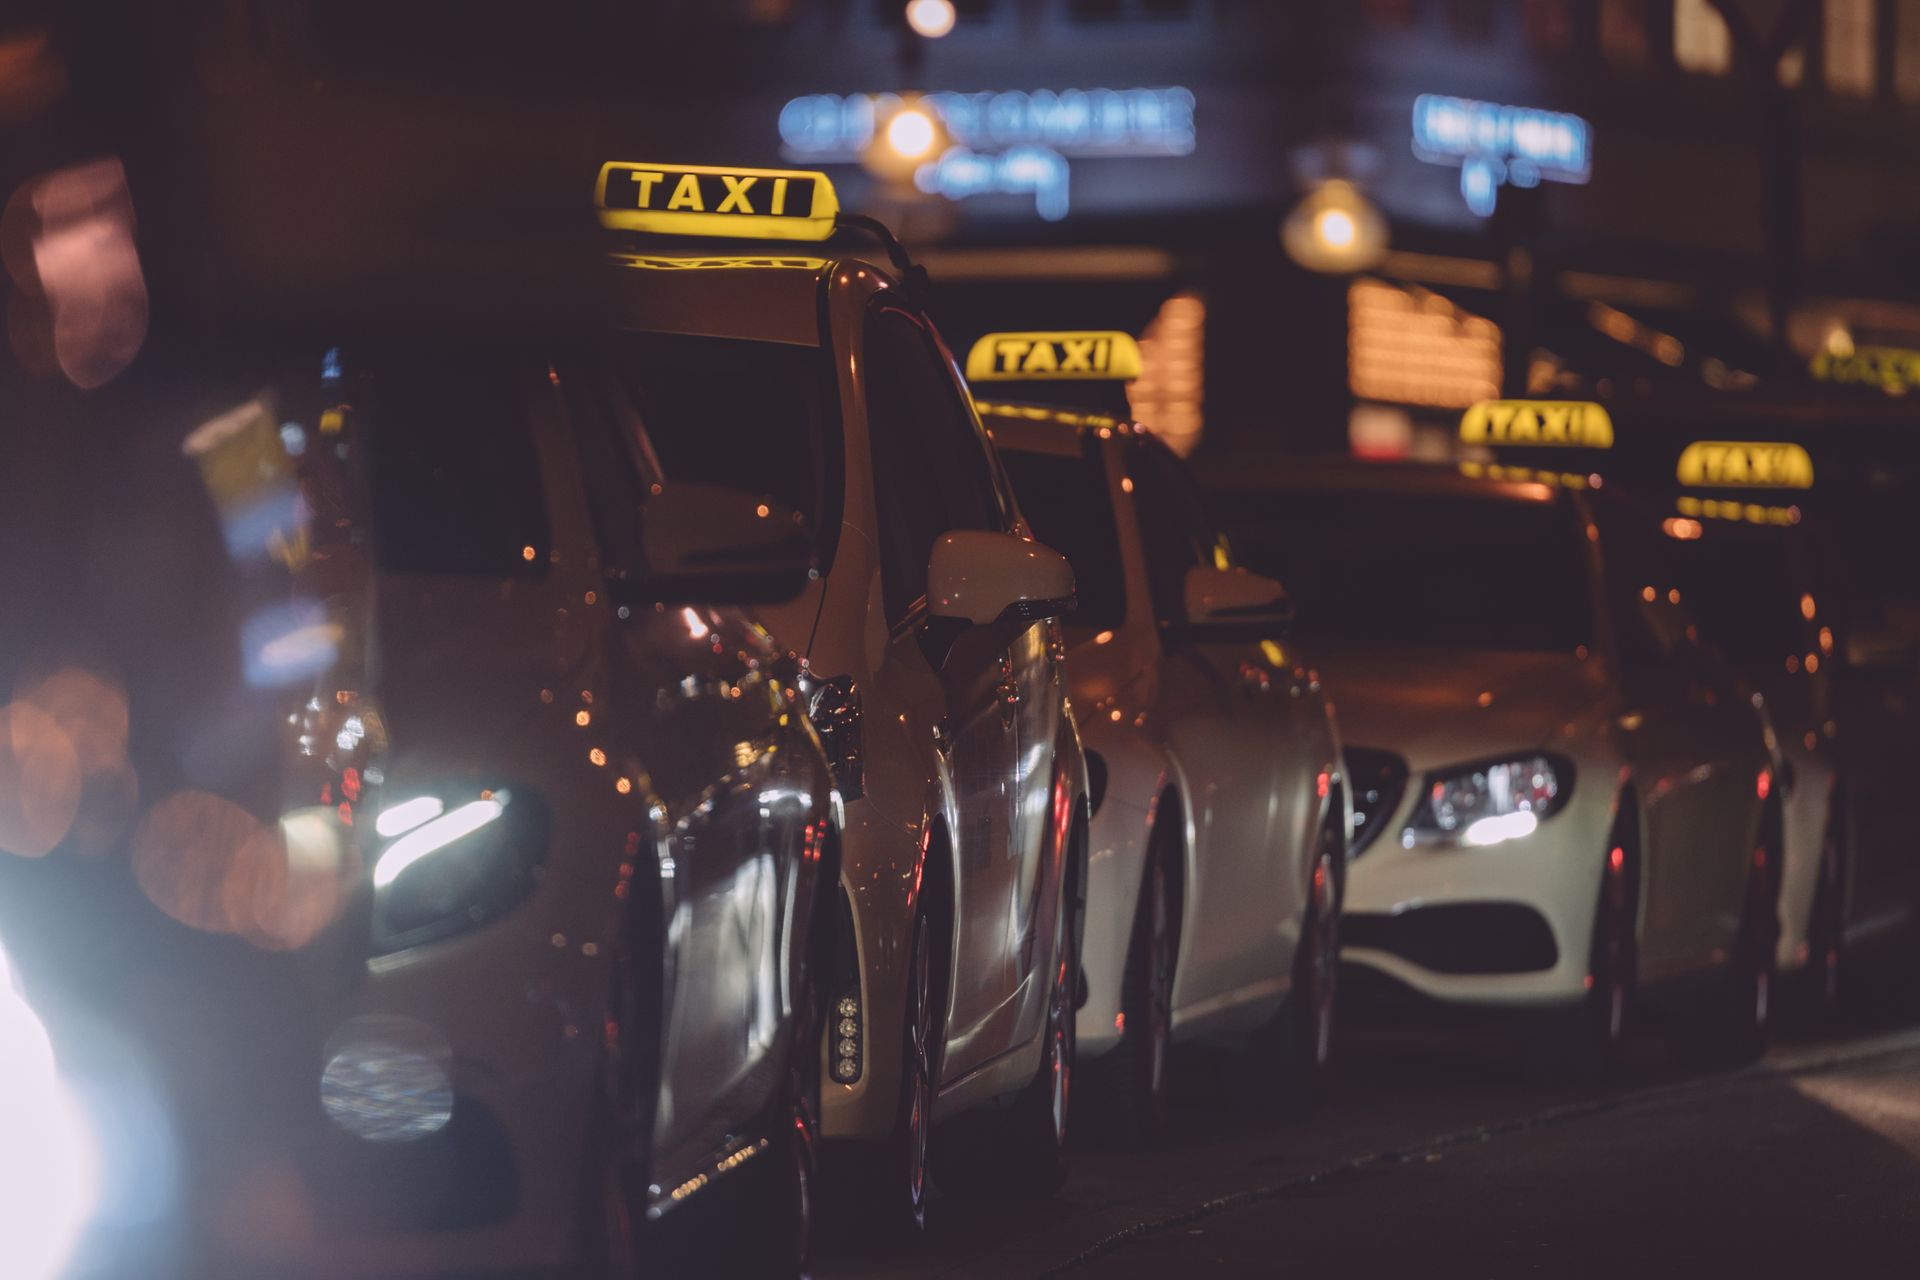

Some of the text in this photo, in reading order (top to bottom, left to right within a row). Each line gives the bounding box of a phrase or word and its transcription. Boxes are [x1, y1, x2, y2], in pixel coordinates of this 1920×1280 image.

[630, 171, 788, 215] TAXI
[996, 340, 1108, 372] TAXI
[1490, 406, 1585, 442] TAXI
